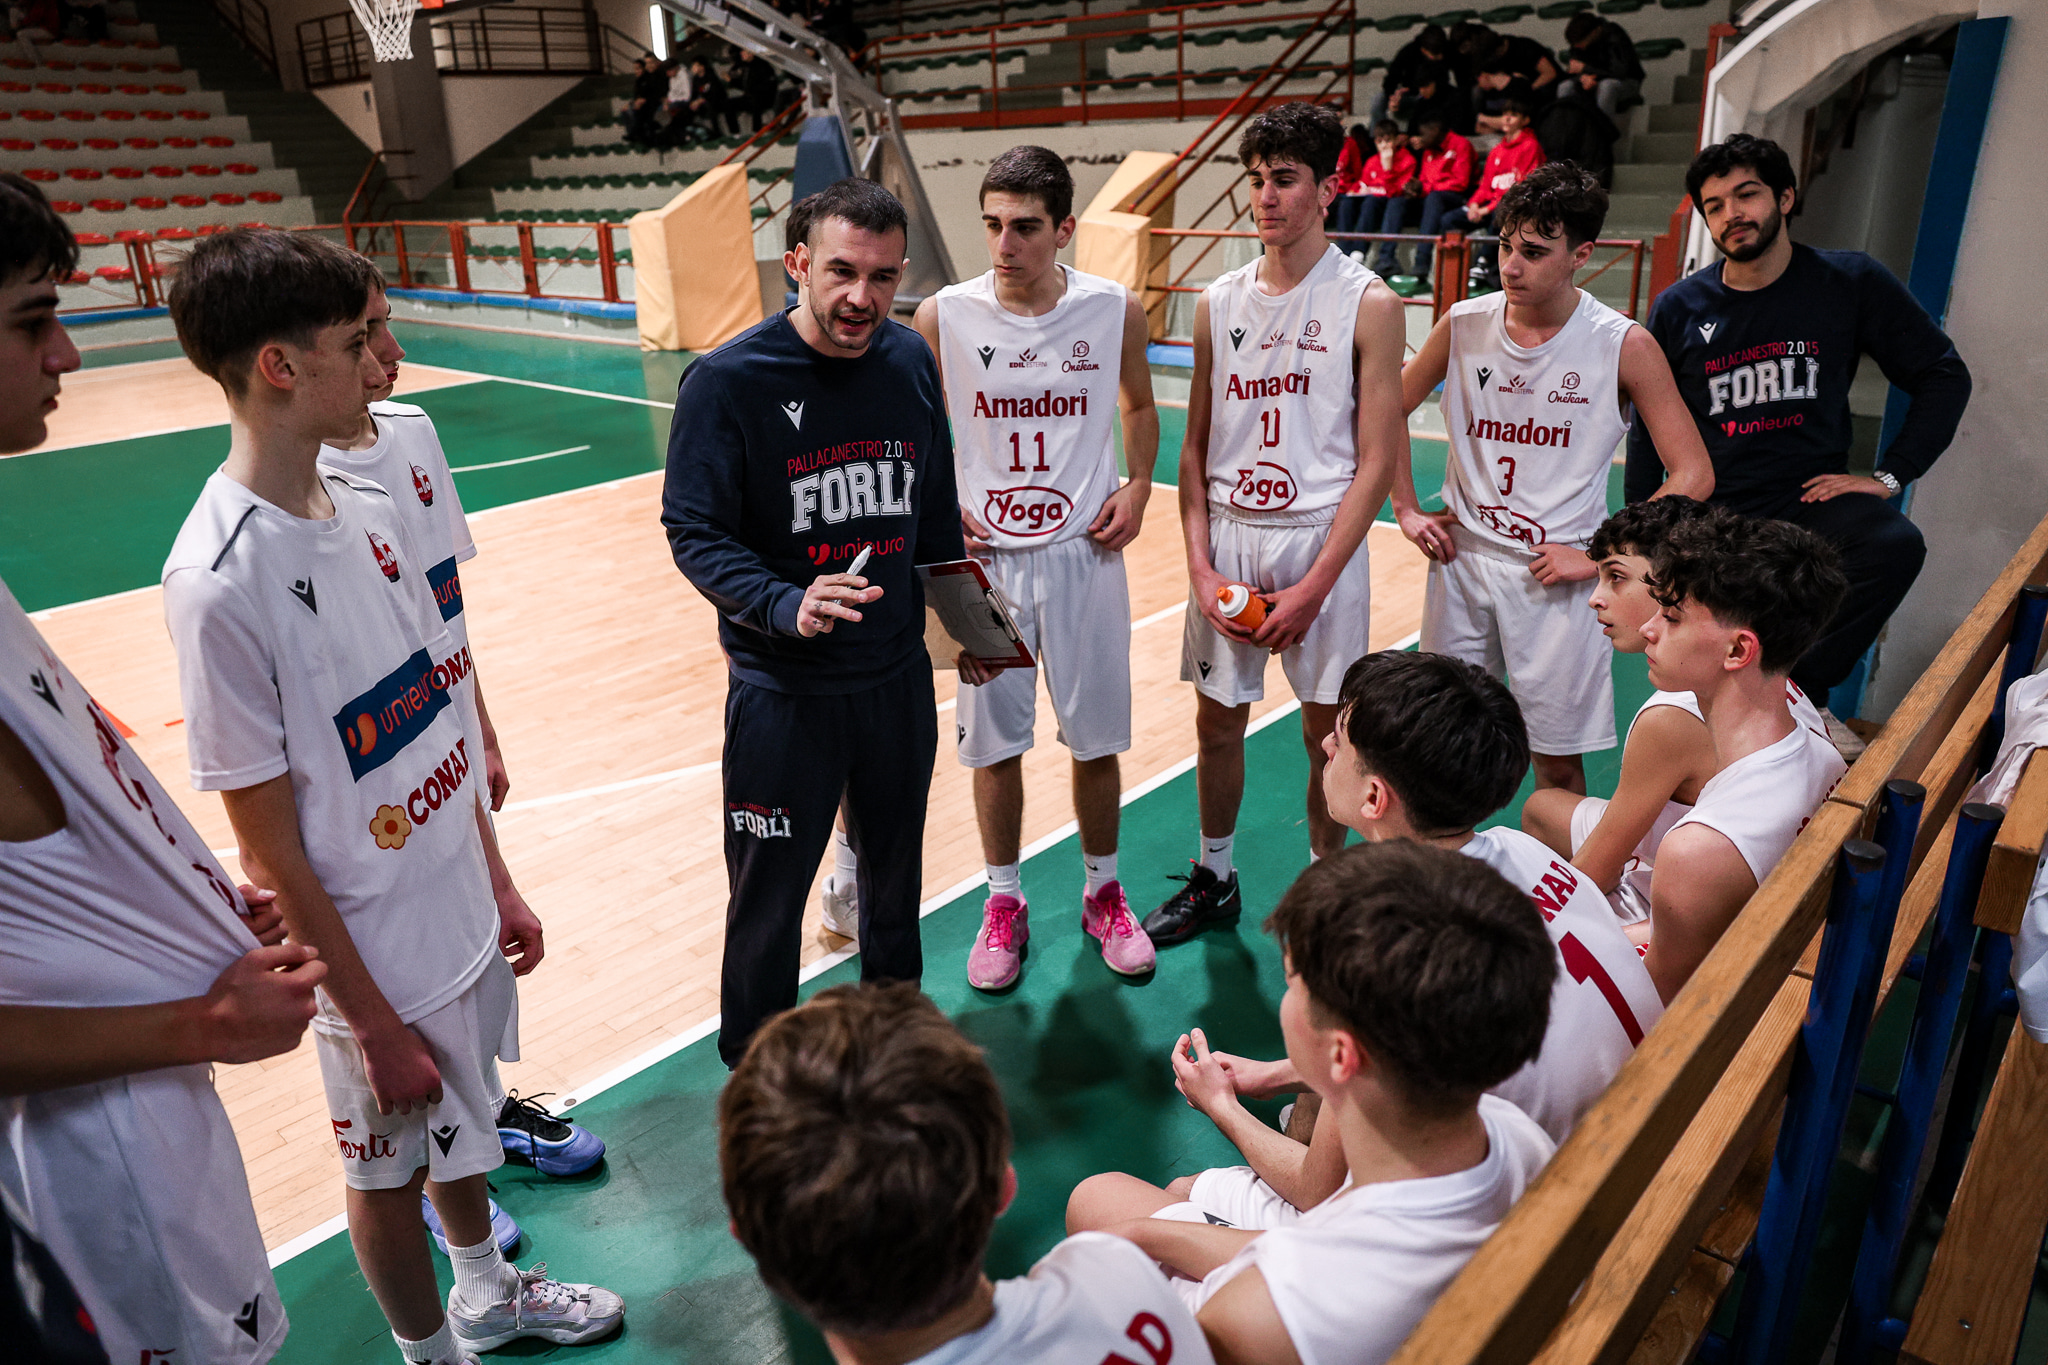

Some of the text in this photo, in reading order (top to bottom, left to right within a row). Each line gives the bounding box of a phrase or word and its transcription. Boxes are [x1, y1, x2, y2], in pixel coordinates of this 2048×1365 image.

[1061, 359, 1100, 373] OneTeam
[1704, 340, 1819, 375] PALLACANESTRO 2.015
[973, 387, 1088, 418] Amadori
[1547, 390, 1590, 404] OneTeam
[1708, 357, 1820, 416] FORLÌ
[1738, 413, 1804, 434] unieuro
[786, 440, 916, 477] PALLACANESTRO 2.015
[1008, 431, 1050, 472] 11
[1497, 456, 1516, 496] 3
[790, 460, 916, 533] FORLÌ
[995, 494, 1063, 530] Yoga
